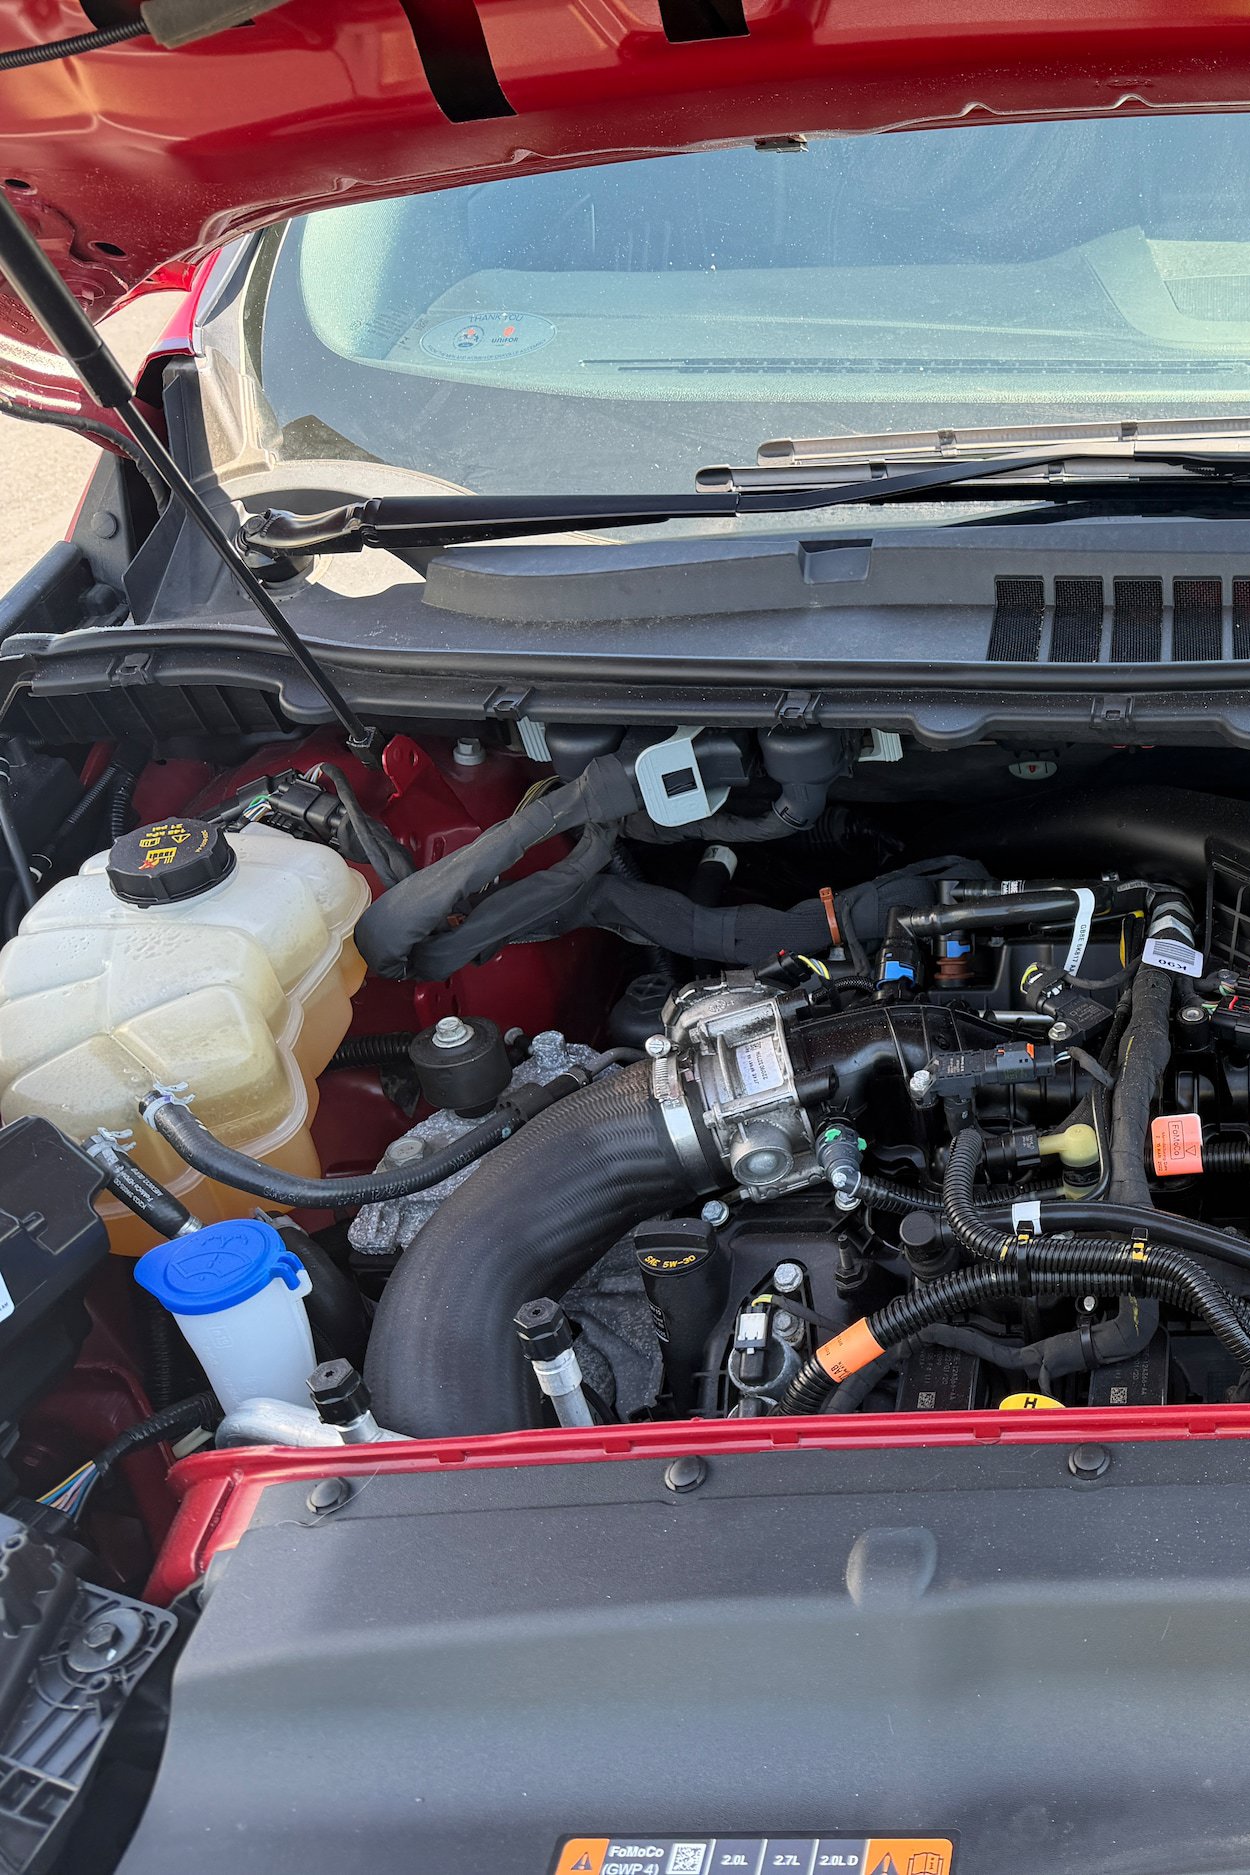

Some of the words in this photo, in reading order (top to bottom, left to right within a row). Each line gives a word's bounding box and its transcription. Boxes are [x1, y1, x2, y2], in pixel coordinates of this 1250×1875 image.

[470, 313, 501, 323] THANK
[503, 313, 525, 322] YOU
[491, 336, 519, 344] UNIFOR
[1158, 959, 1186, 970] K90
[1172, 1125, 1181, 1156] FoMoCo
[644, 1255, 661, 1267] SAE
[662, 1254, 697, 1268] 5W-30
[609, 1845, 665, 1859] FoMoCo
[721, 1854, 749, 1867] 2.0L
[773, 1854, 801, 1867] 2.7L
